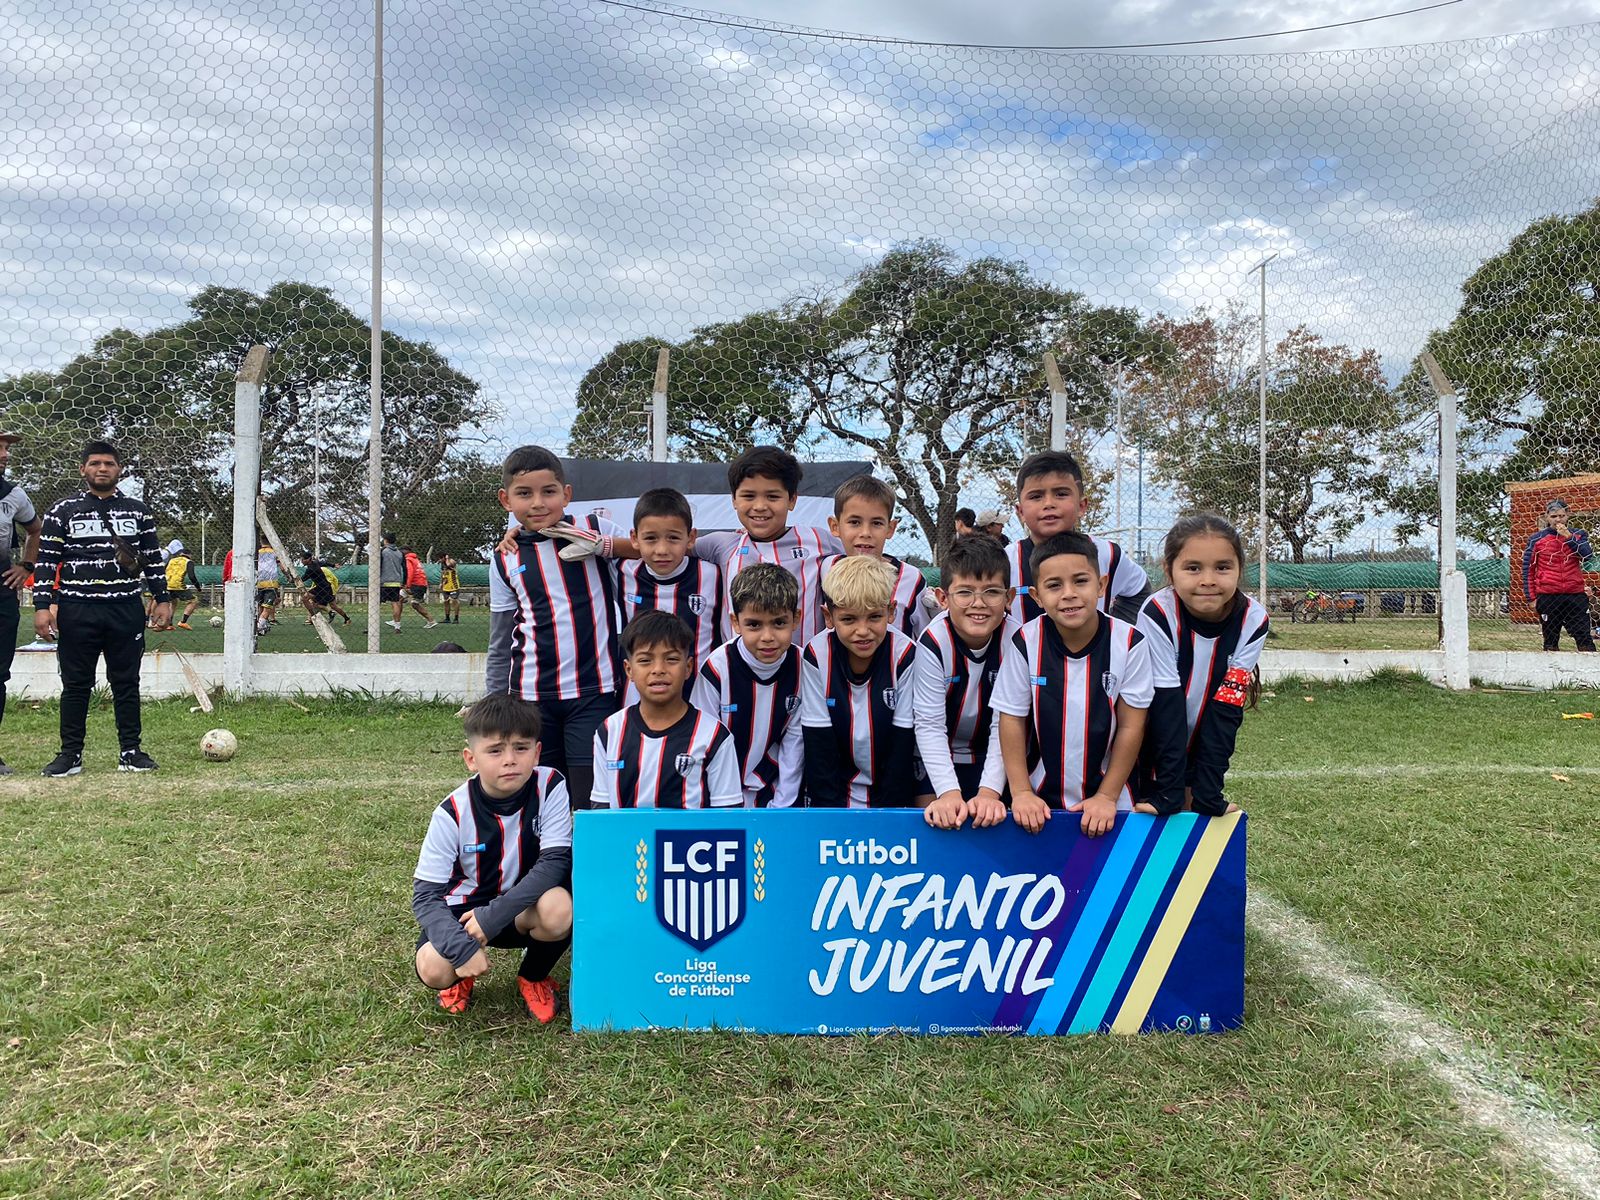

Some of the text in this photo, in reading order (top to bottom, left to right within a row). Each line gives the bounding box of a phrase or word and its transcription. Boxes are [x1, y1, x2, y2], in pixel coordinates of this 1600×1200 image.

[663, 840, 739, 873] LCF
[819, 838, 918, 865] Fútbol
[811, 872, 1066, 934] INFANTO
[654, 971, 750, 984] Concordiense
[685, 958, 717, 972] Liga
[808, 935, 1055, 996] JUVENIL
[669, 984, 735, 996] de Fútbol
